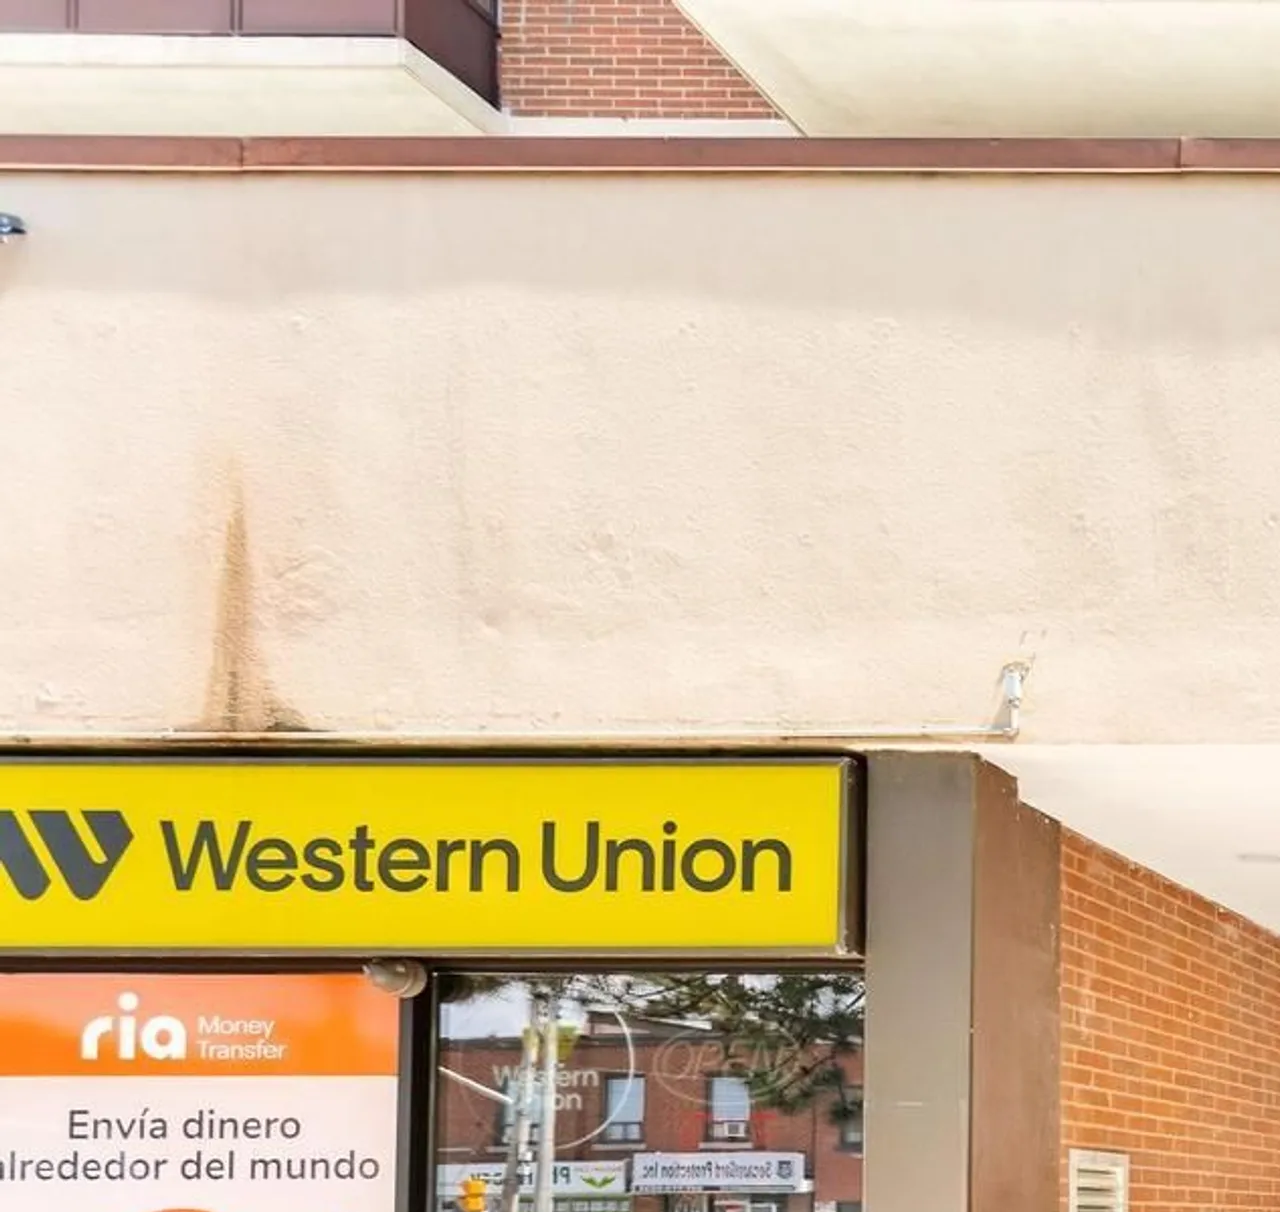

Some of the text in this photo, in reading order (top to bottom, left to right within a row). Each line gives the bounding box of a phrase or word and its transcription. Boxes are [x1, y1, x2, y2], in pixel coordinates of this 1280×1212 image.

[160, 821, 793, 893] Western Union
[81, 991, 188, 1060] ria
[198, 1015, 275, 1039] Money
[196, 1039, 288, 1060] Transfer
[68, 1107, 302, 1140] Envía dinero
[0, 1150, 380, 1181] lrededor del mundo
